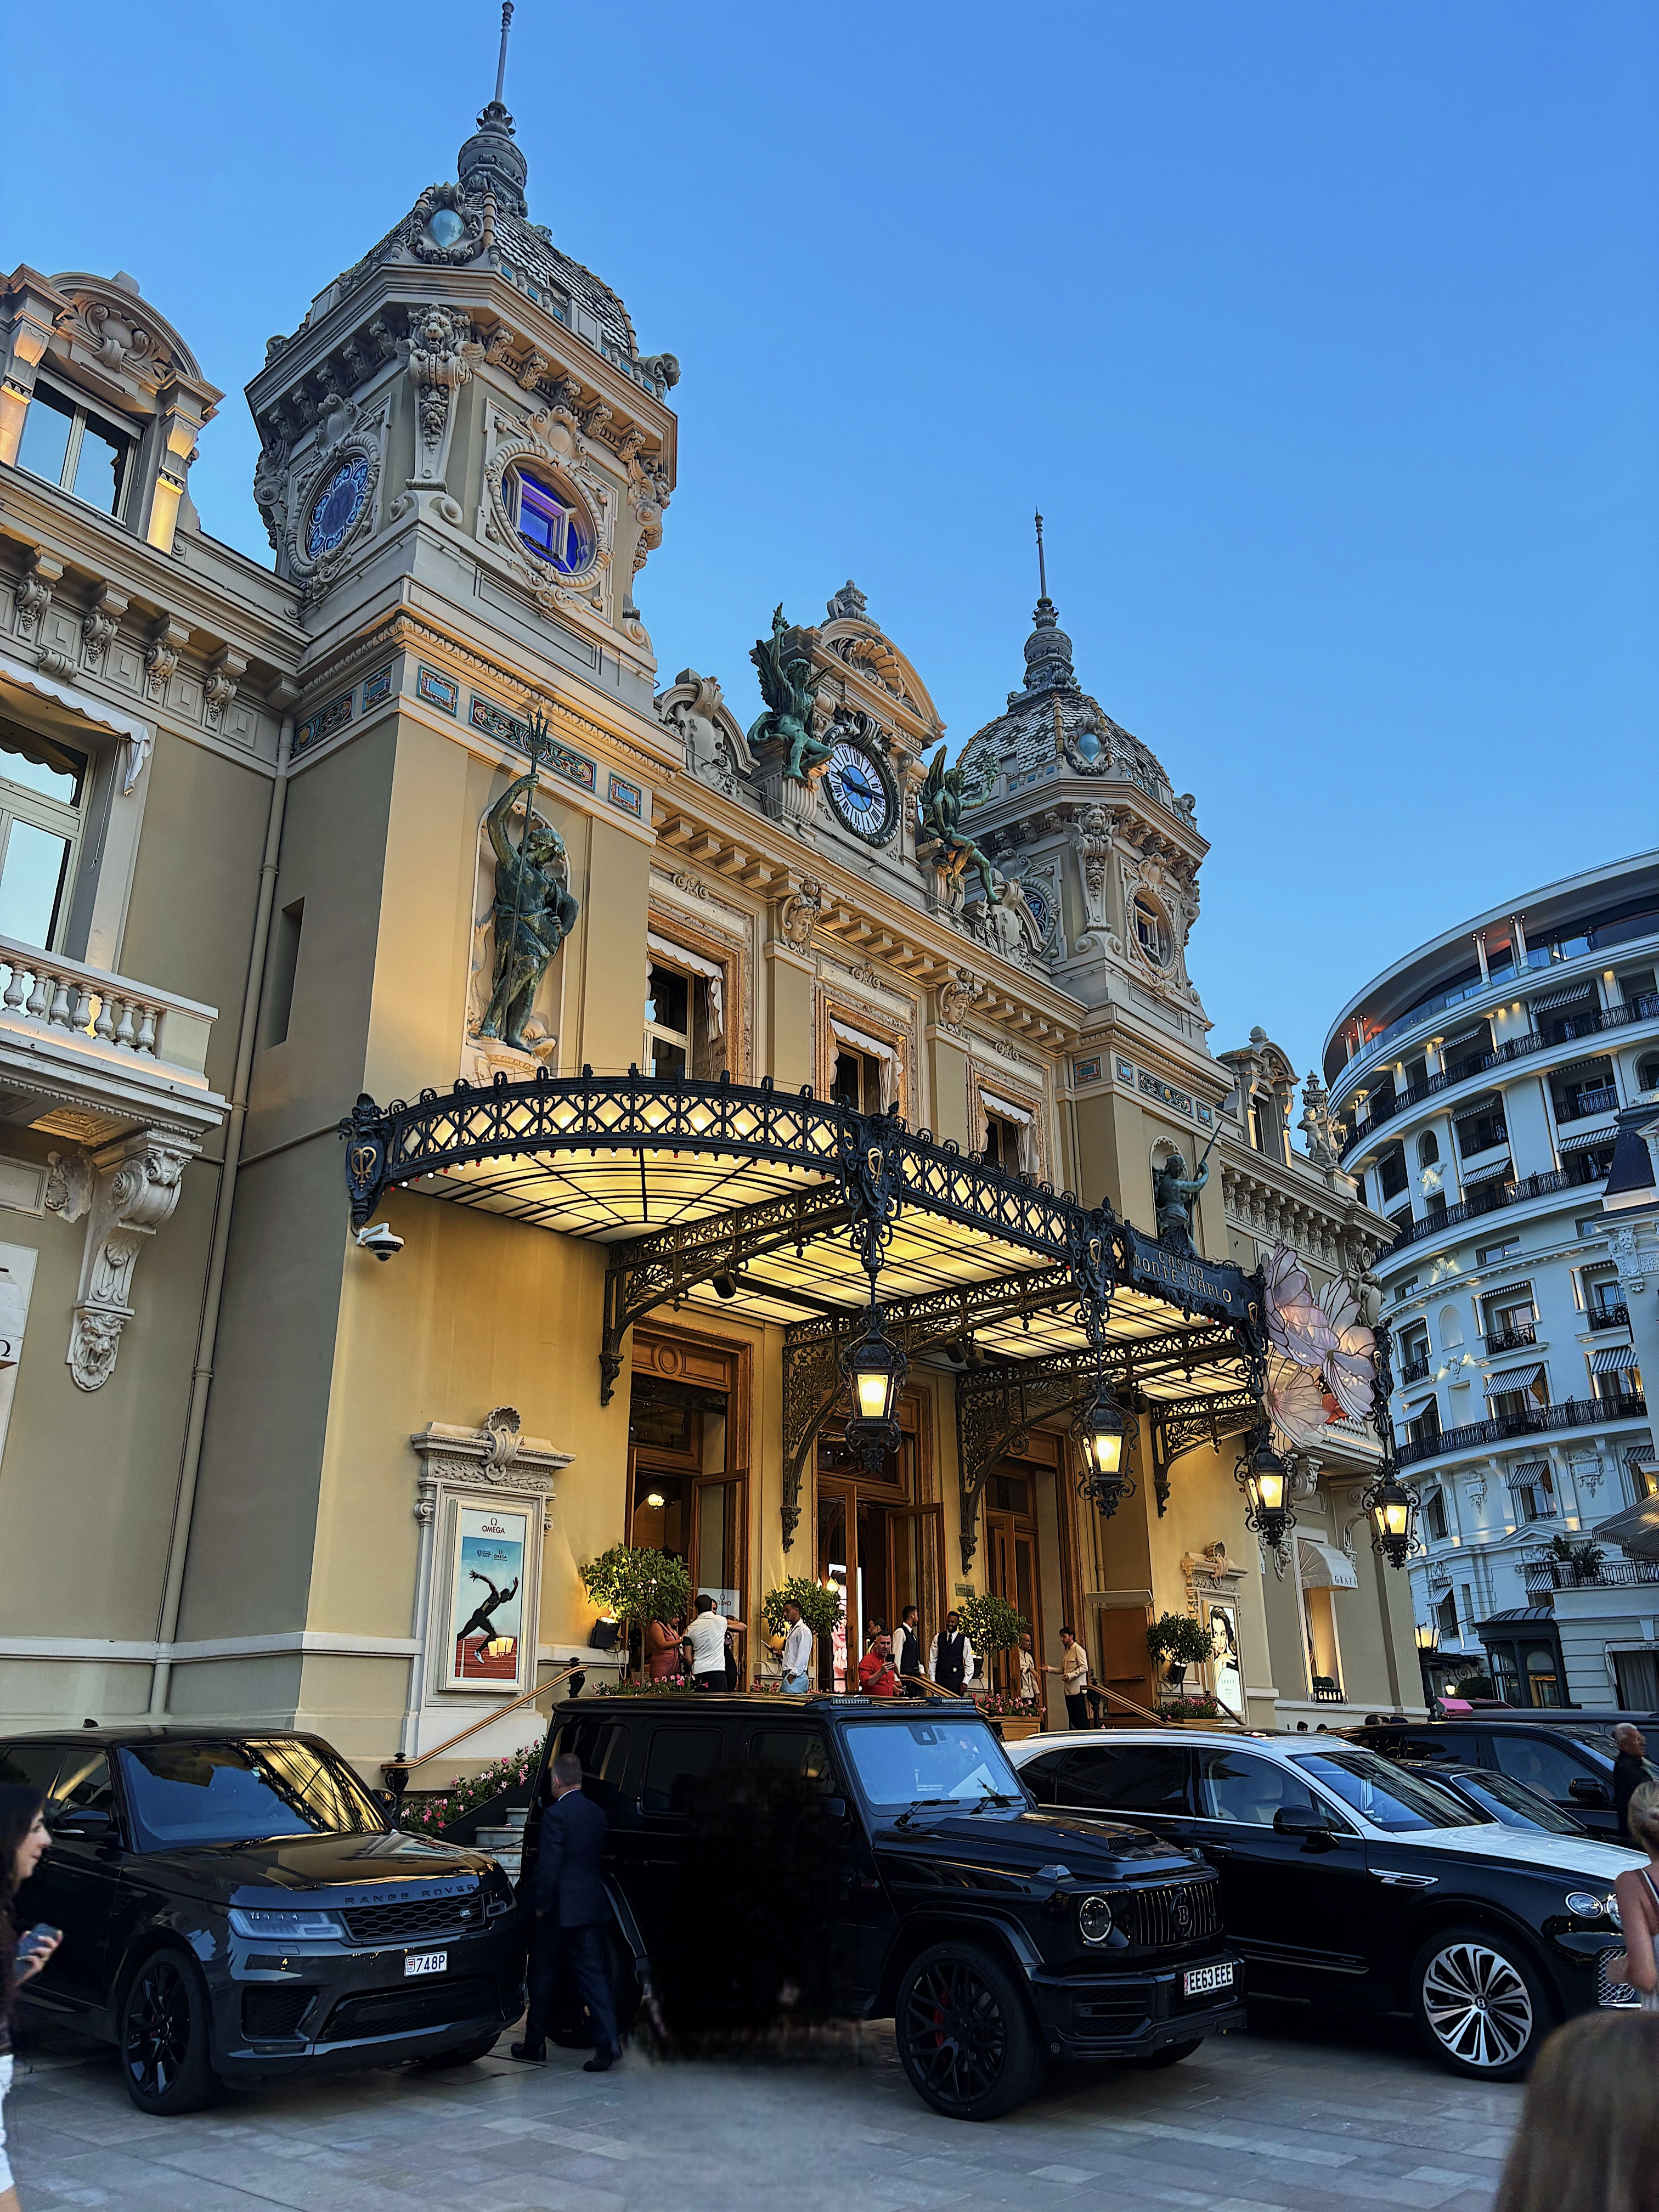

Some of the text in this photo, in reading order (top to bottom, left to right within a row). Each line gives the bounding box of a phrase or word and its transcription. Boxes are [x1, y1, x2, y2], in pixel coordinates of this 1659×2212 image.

[1158, 1251, 1204, 1279] CASINO
[1133, 1253, 1232, 1304] MONTE-CARLO
[482, 1525, 505, 1534] OMEGA
[345, 1883, 476, 1905] RANGE ROVER
[416, 1955, 445, 1973] 748P
[1189, 1964, 1232, 1991] EE63 EEE
